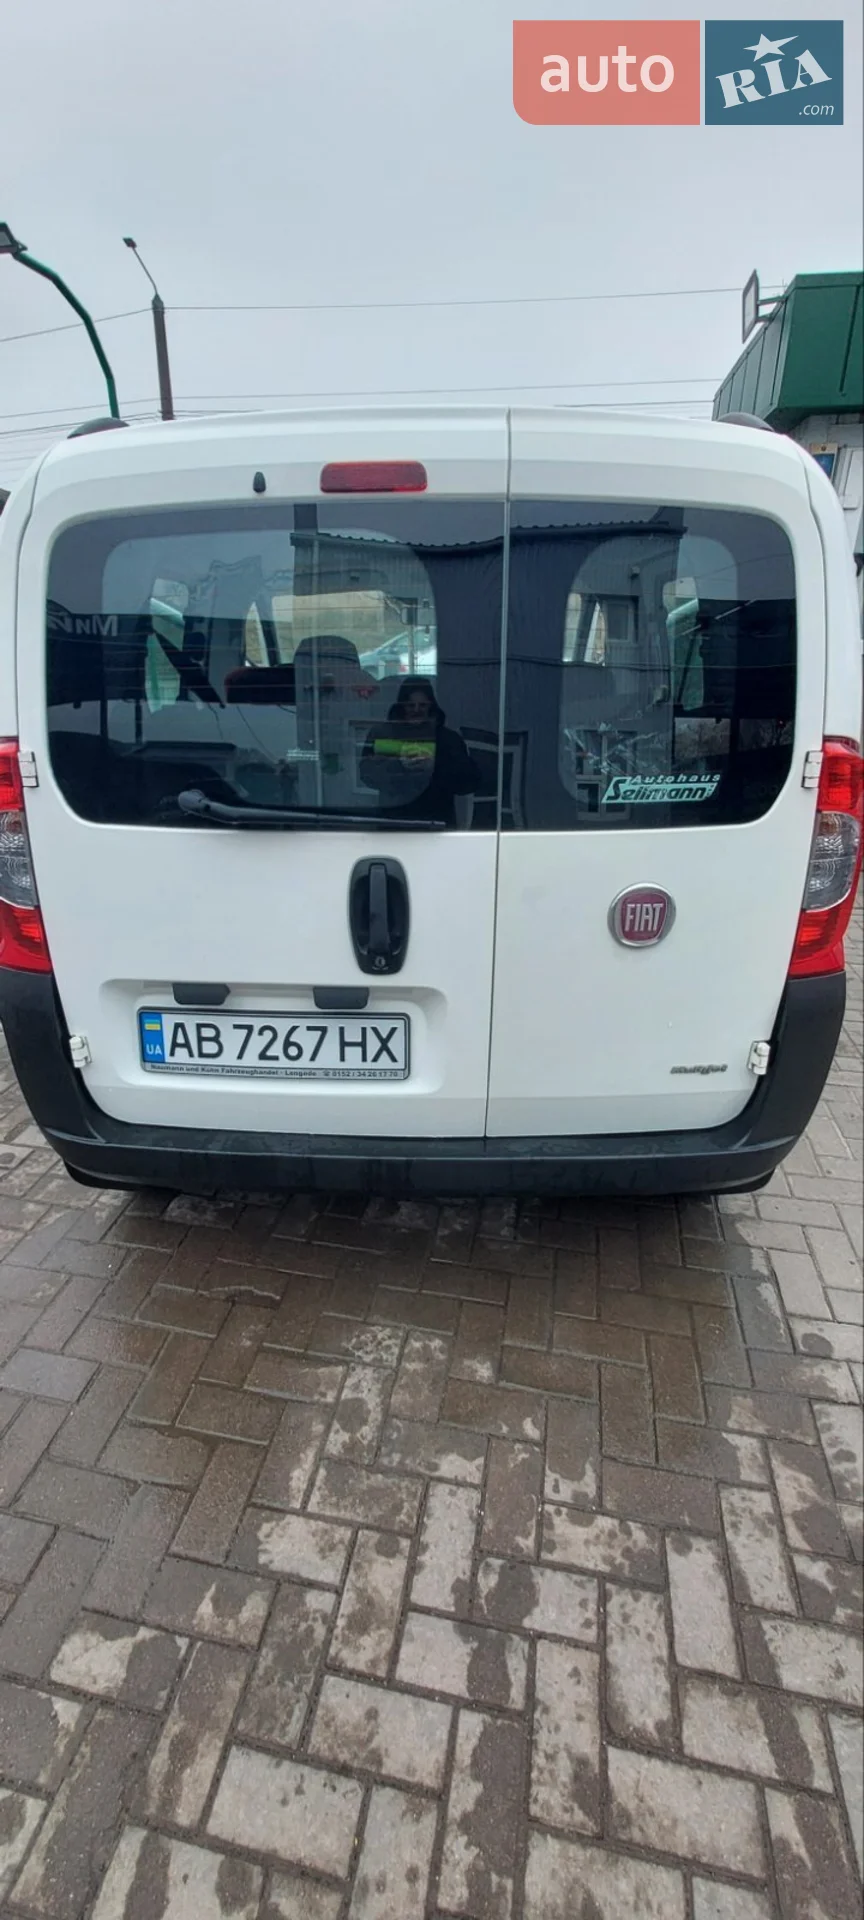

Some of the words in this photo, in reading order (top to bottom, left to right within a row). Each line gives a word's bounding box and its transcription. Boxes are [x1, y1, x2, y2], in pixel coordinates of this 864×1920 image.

[631, 773, 721, 784] Autohaus
[624, 903, 664, 931] FIAT
[146, 1043, 162, 1055] UA
[168, 1022, 224, 1059] AB
[232, 1024, 328, 1062] 7267
[338, 1026, 399, 1063] HX
